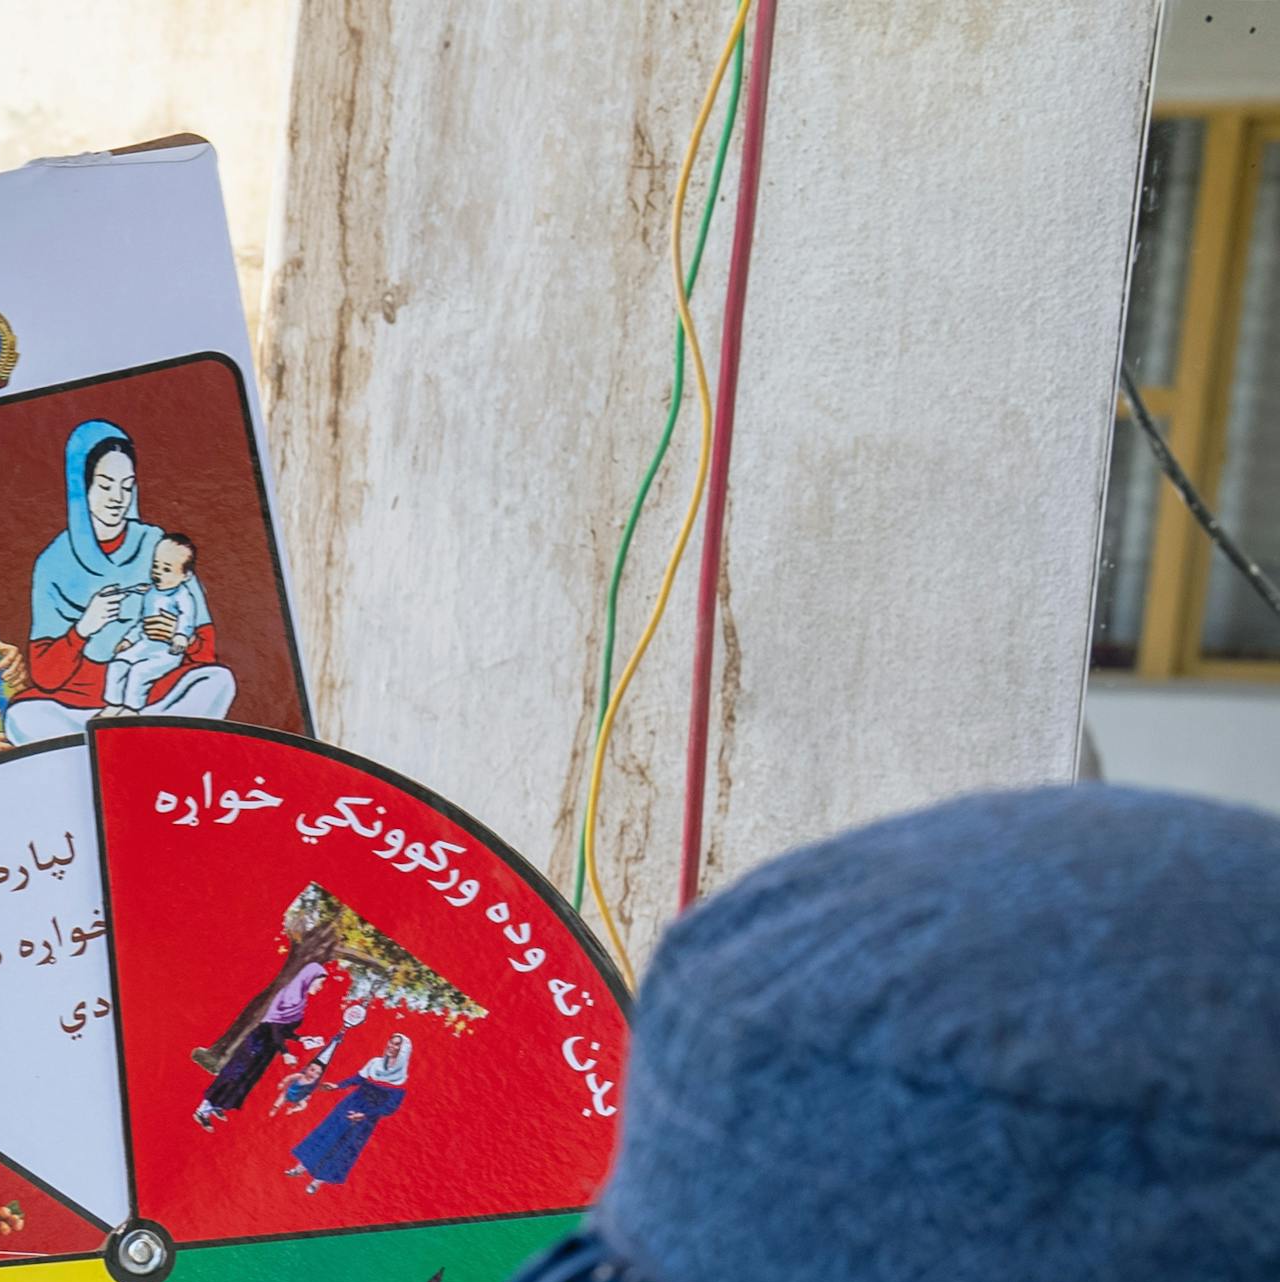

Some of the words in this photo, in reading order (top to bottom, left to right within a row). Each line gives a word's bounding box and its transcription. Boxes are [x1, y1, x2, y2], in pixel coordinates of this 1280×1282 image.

[154, 771, 284, 827] خواړه
[18, 909, 108, 967] خواړه
[485, 902, 547, 973] وده
[547, 978, 595, 1017] ته
[561, 1036, 618, 1118] بدن
